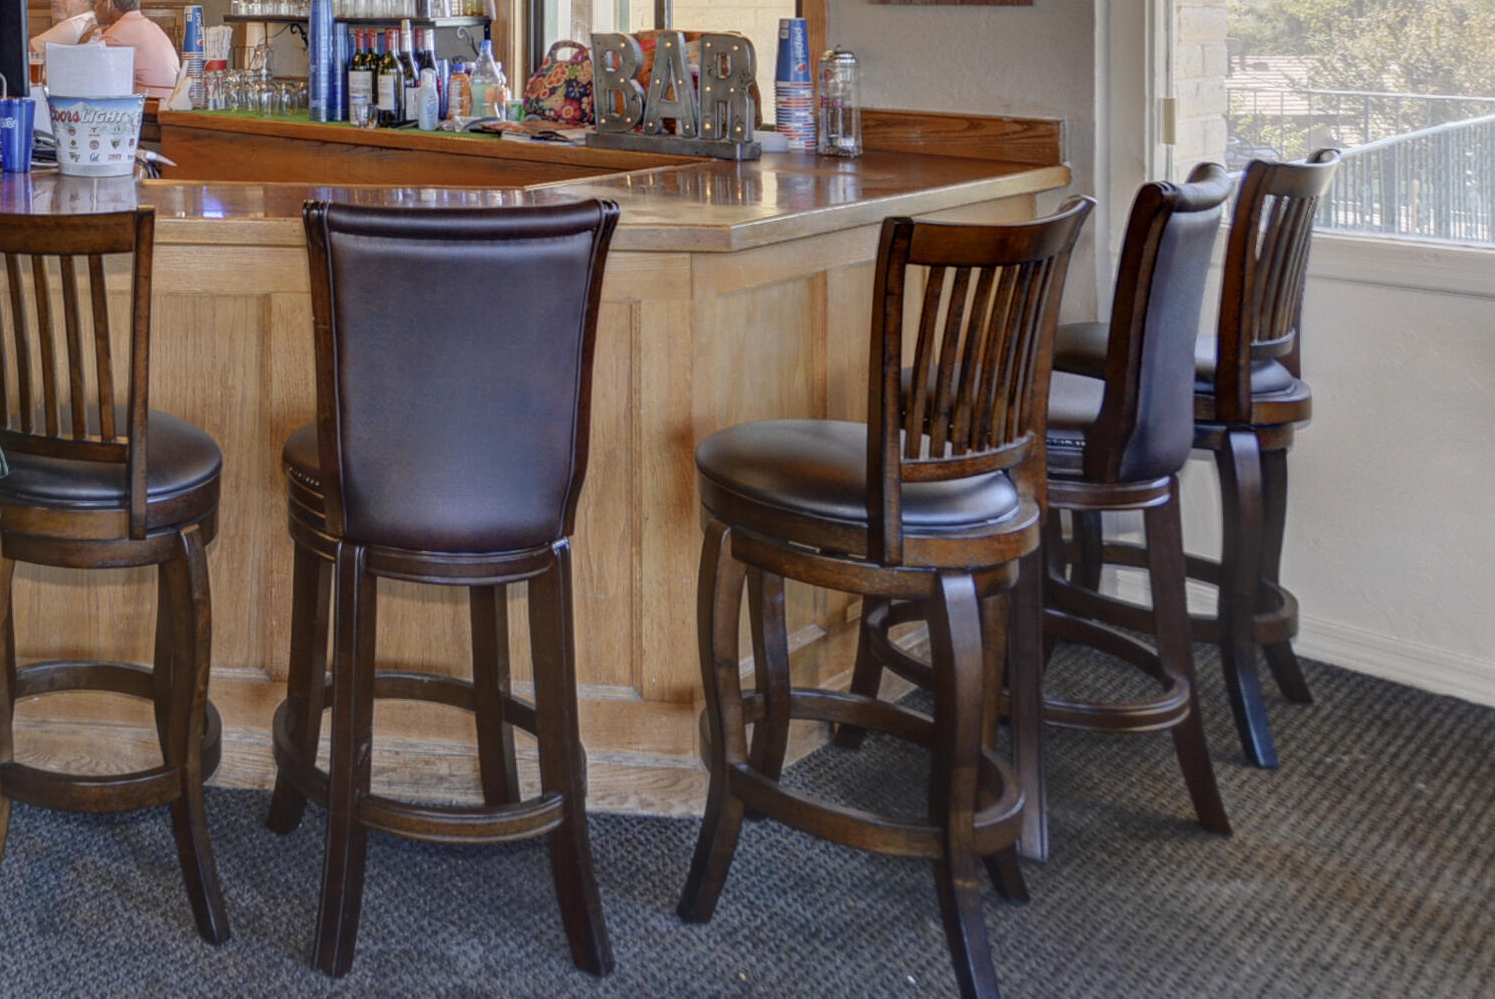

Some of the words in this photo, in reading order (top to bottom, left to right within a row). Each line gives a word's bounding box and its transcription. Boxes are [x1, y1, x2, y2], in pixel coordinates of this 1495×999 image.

[793, 26, 805, 59] pepsi
[590, 32, 756, 143] BAR
[81, 110, 126, 124] LIGHT
